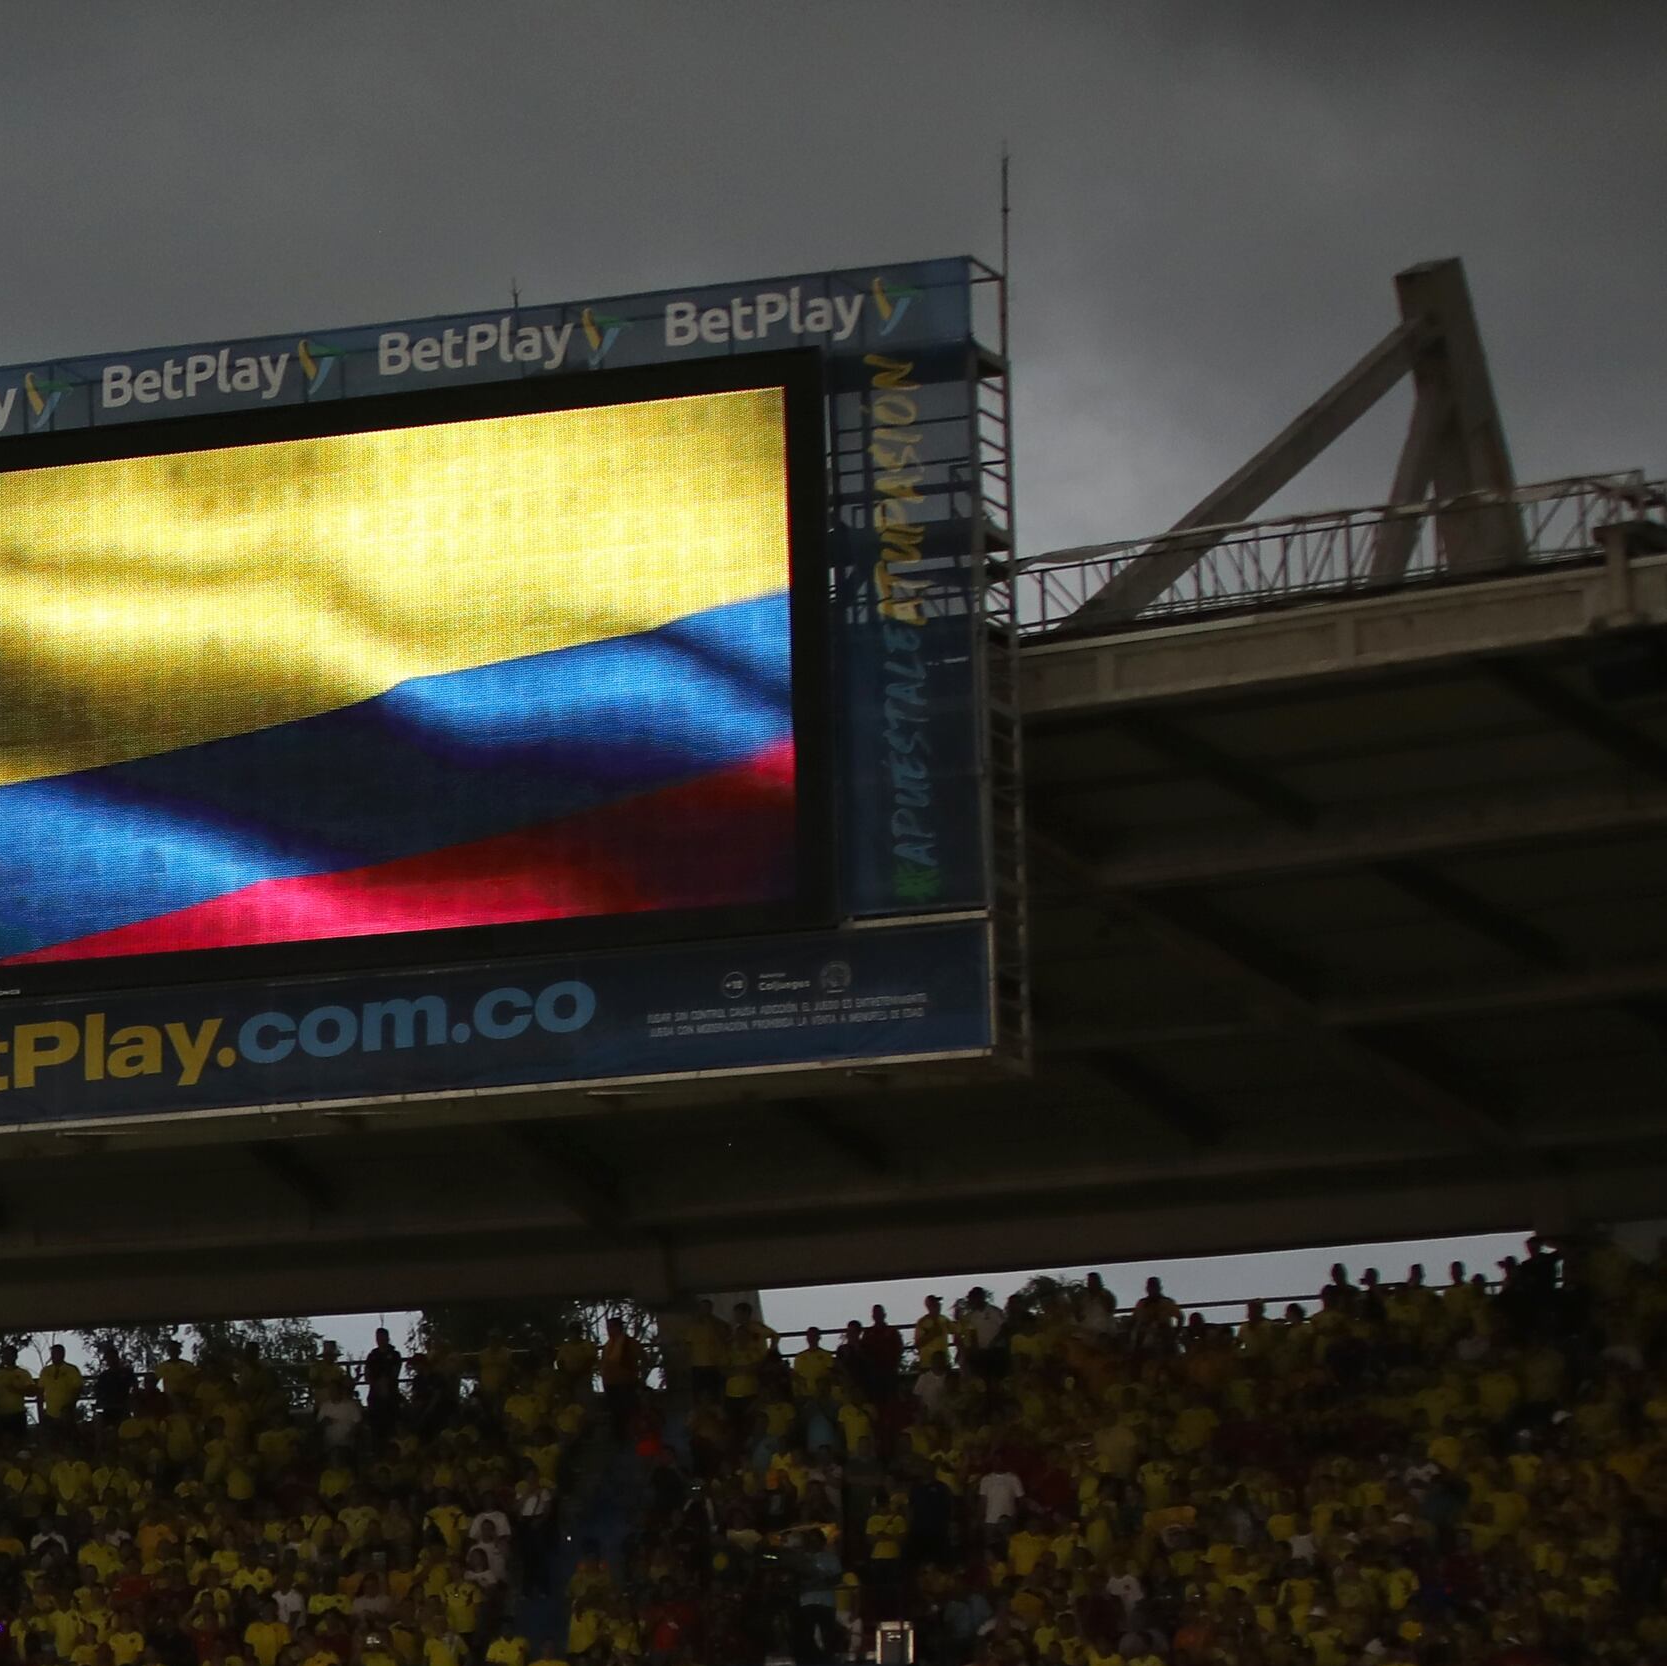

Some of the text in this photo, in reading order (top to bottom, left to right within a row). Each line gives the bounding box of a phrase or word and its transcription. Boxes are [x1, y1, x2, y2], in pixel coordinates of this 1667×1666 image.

[377, 316, 574, 376] BetPlay
[667, 287, 862, 347] BetPlay
[101, 346, 291, 410] BetPlay
